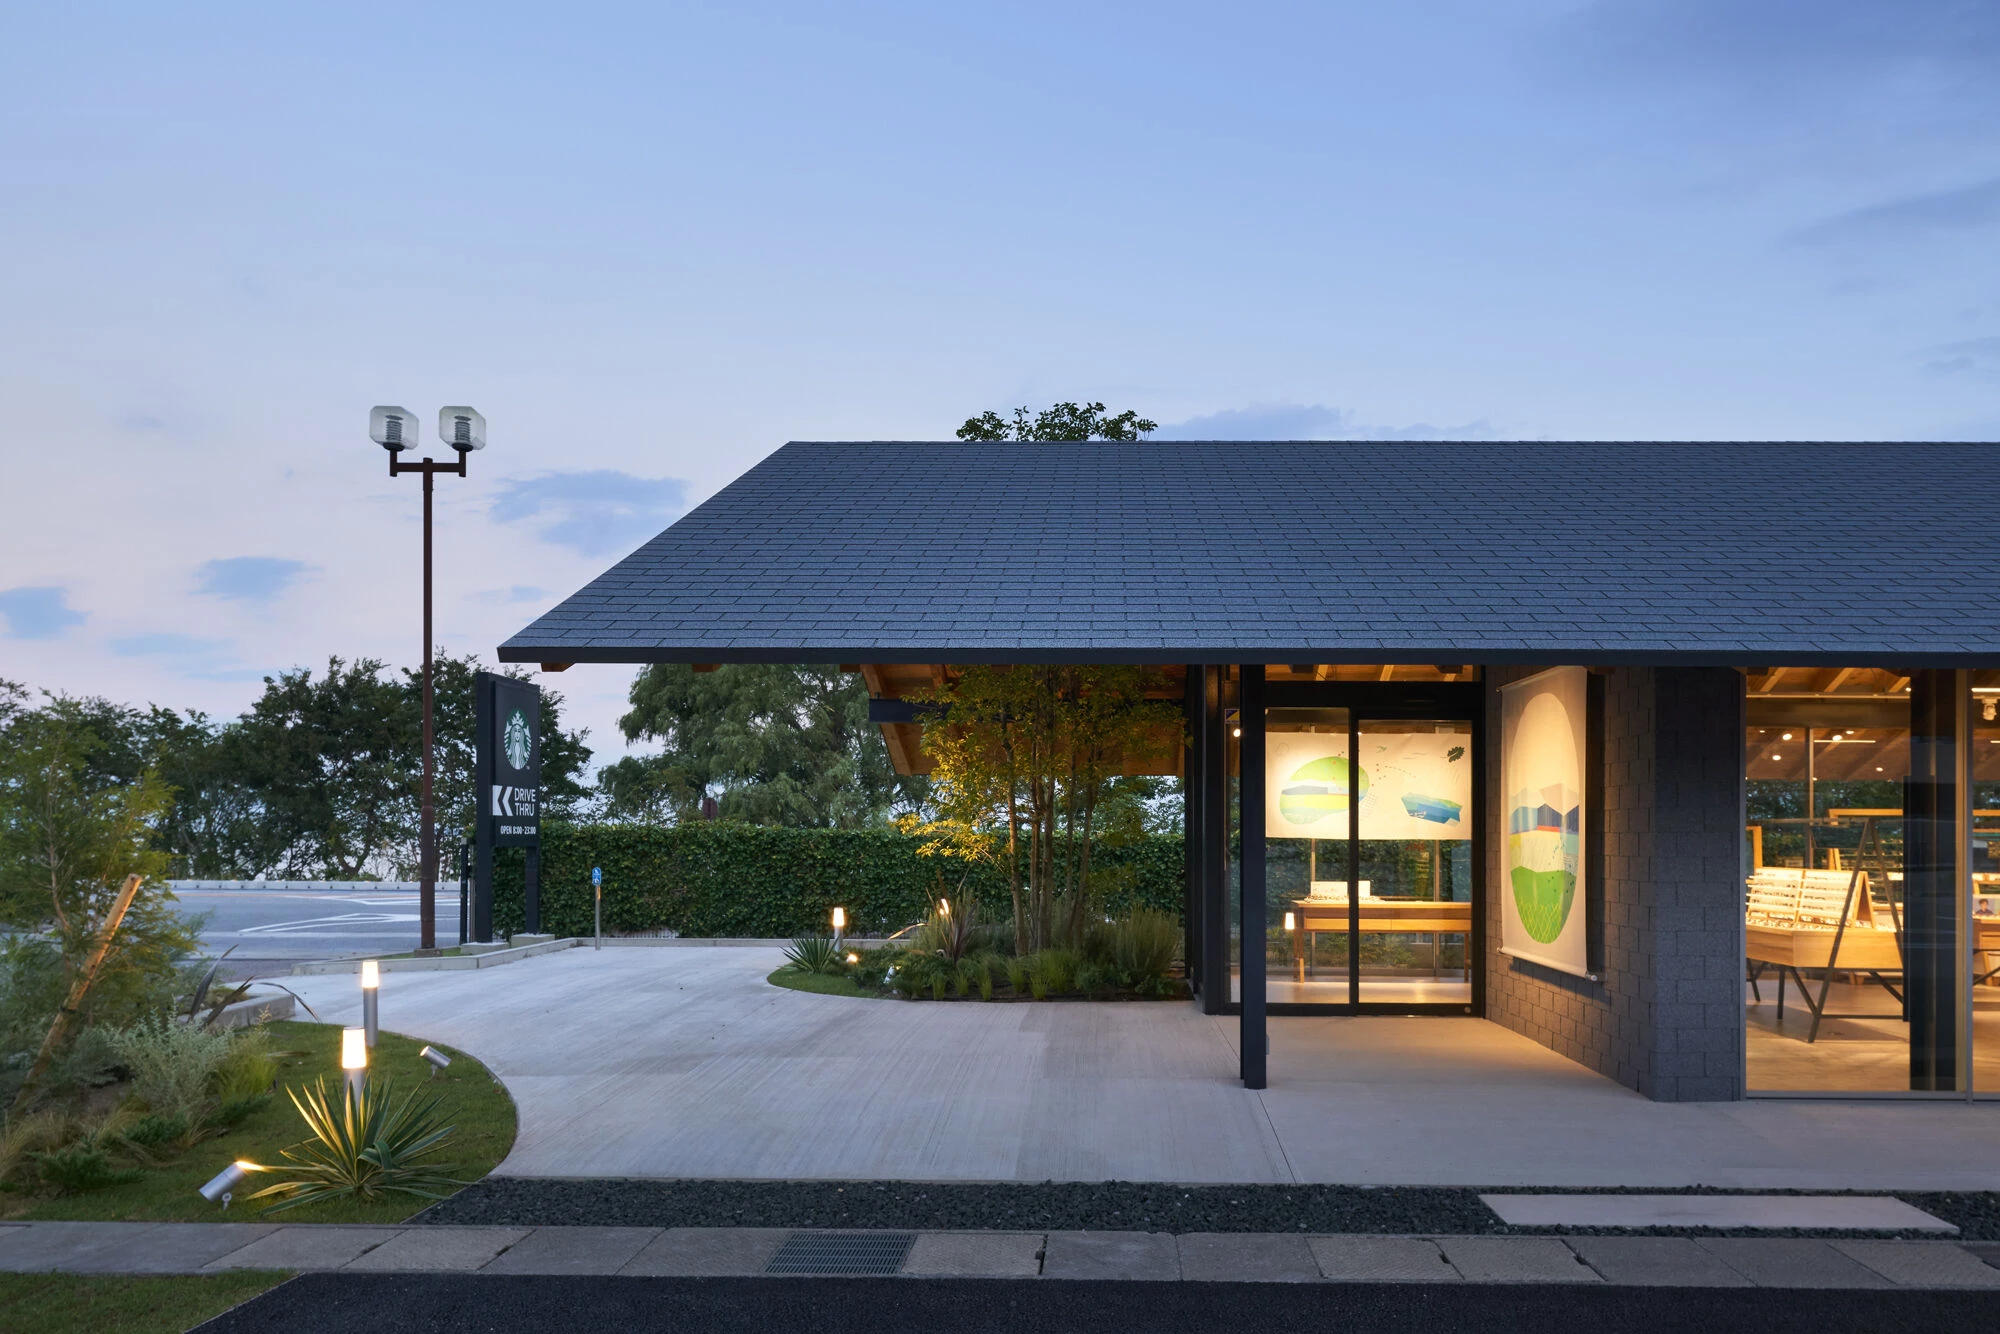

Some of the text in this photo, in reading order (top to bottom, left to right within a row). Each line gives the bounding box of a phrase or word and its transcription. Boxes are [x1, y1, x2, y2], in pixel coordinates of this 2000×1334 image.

[514, 787, 536, 802] DRIVE
[514, 802, 535, 817] THRU
[500, 825, 512, 835] OPEN
